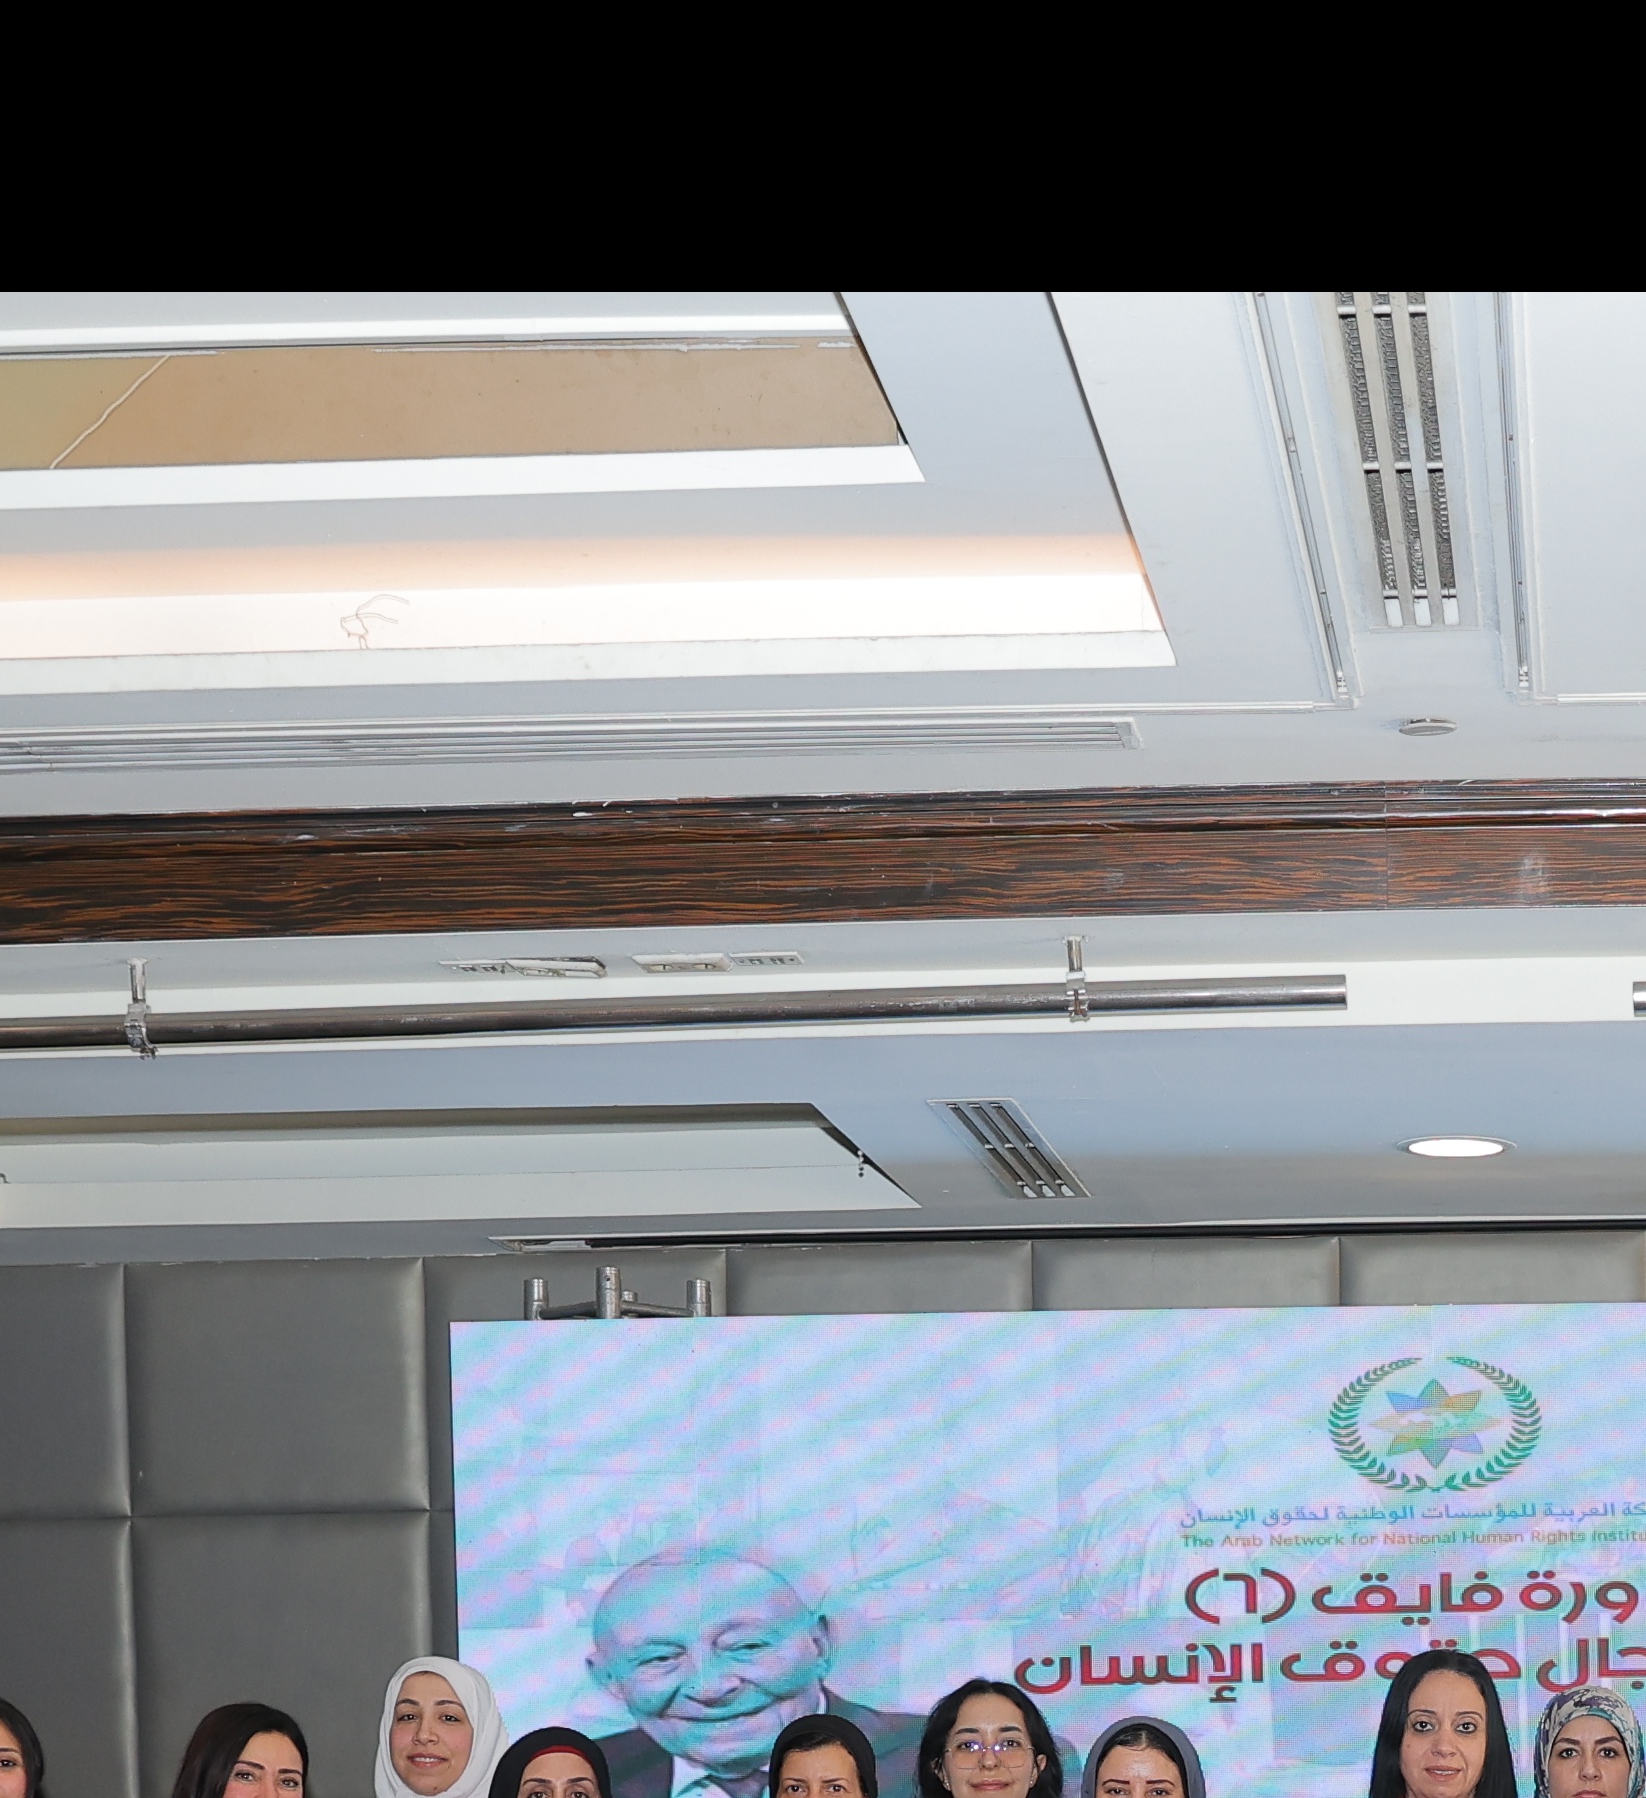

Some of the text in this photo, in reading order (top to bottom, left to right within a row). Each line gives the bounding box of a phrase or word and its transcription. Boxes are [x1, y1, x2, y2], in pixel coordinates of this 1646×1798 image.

[1180, 1507, 1255, 1529] الإنسان
[1262, 1506, 1330, 1526] لحقوق
[1336, 1505, 1415, 1528] الوطنية
[1421, 1503, 1537, 1523] للمؤسسات
[1543, 1502, 1615, 1522] العربية
[1181, 1534, 1214, 1547] The
[1221, 1534, 1262, 1547] Arab
[1270, 1533, 1344, 1547] Network
[1352, 1533, 1376, 1545] for
[1383, 1531, 1456, 1544] National
[1463, 1531, 1524, 1543] Human
[1531, 1530, 1586, 1544] Rights
[1185, 1568, 1296, 1625] (٦)
[1312, 1571, 1504, 1626] فايق
[1280, 1639, 1522, 1683] حوق
[1014, 1642, 1264, 1703] الإنسان
